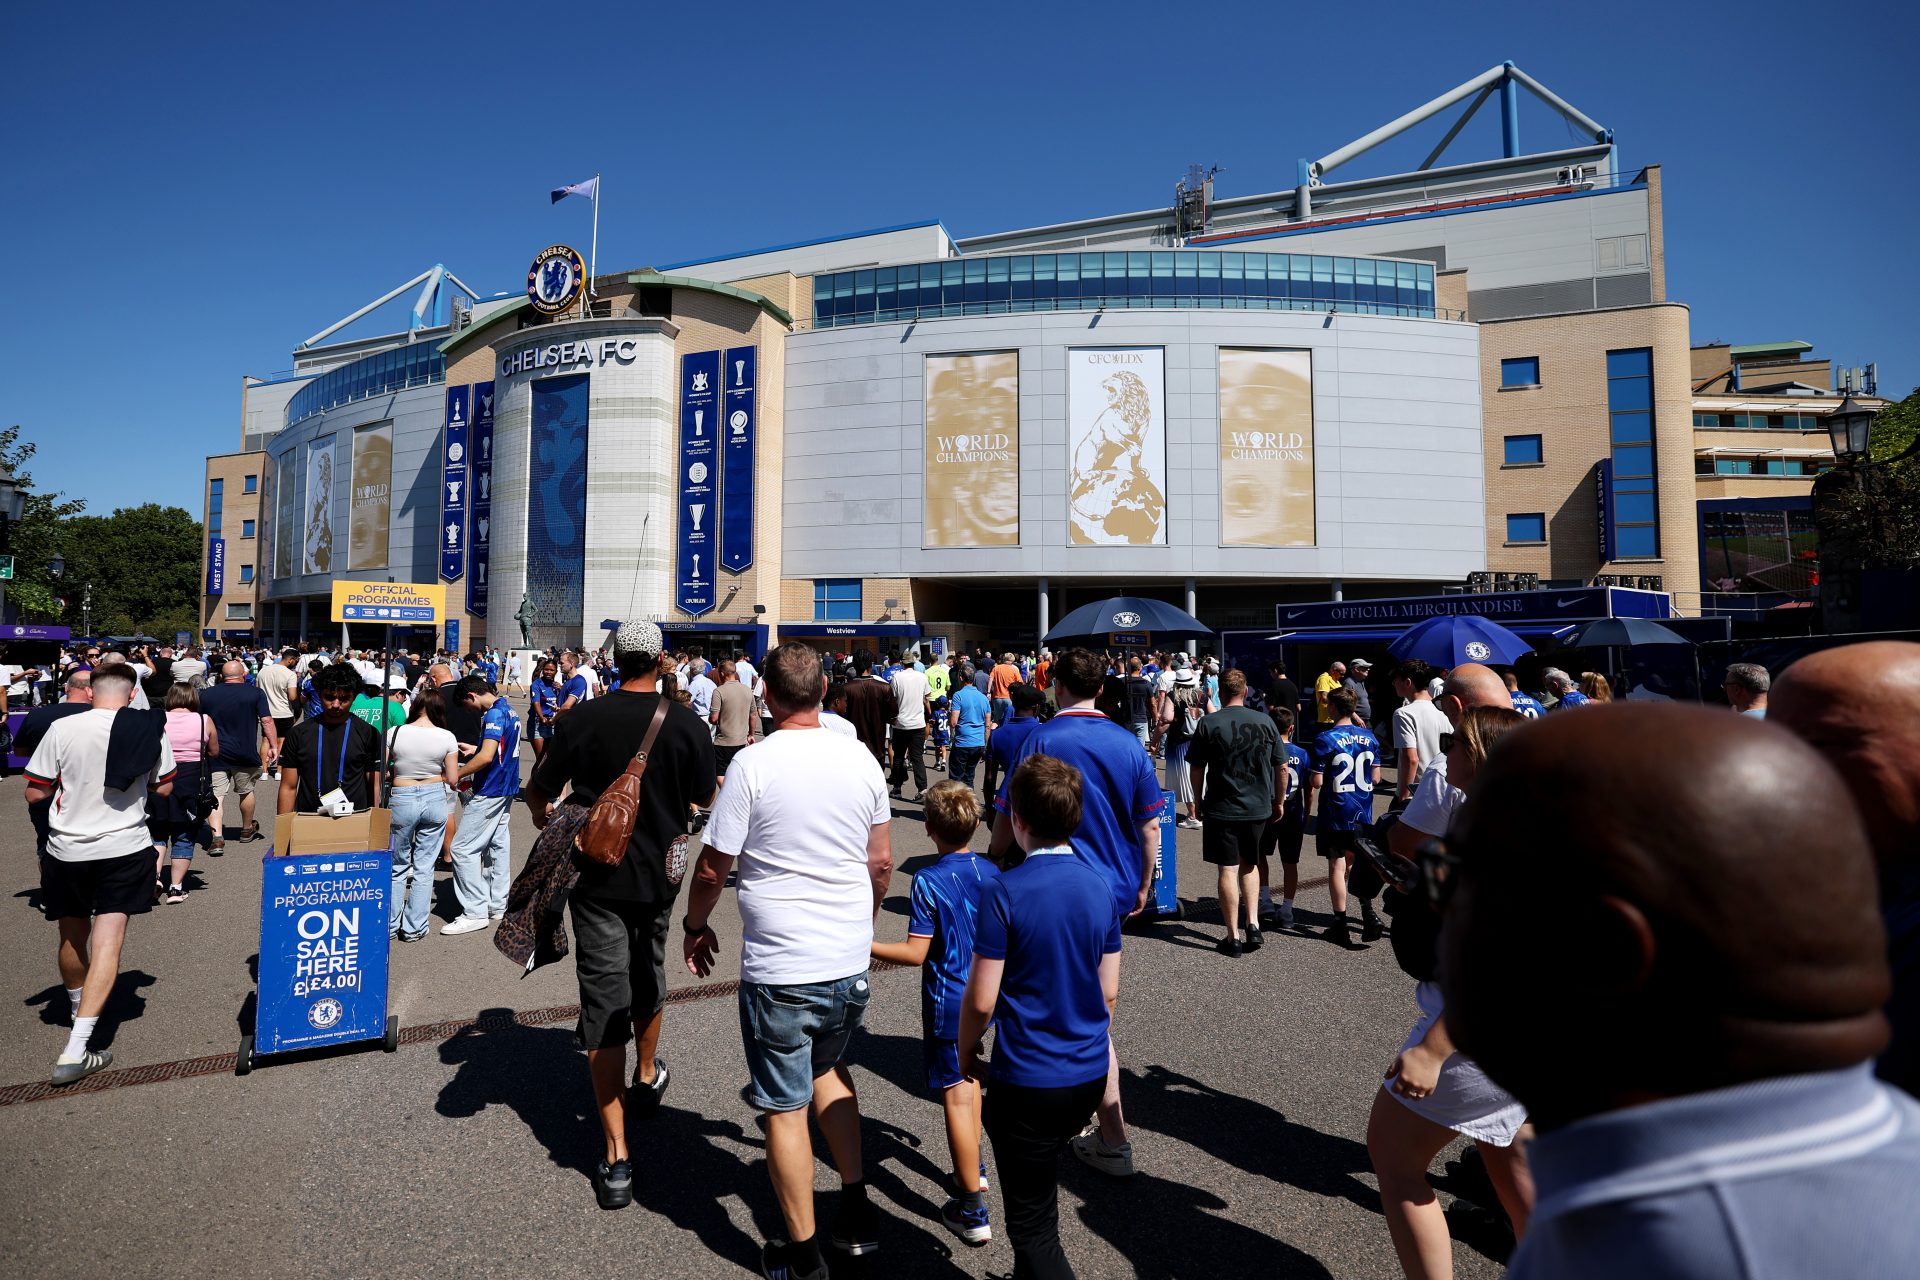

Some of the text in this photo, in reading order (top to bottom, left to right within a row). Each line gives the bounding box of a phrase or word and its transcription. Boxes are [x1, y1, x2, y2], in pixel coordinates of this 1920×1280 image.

[536, 246, 573, 264] CHELSEA
[501, 338, 637, 377] CHELSEA FC
[936, 433, 1009, 452] WORLD
[1231, 431, 1303, 449] WORLD
[936, 450, 1009, 463] CHAMPIONS
[1231, 448, 1303, 460] CHAMPIONS
[356, 483, 388, 499] WORLD
[355, 497, 388, 508] CHAMPIONS
[363, 584, 417, 595] OFFICIAL
[348, 594, 431, 606] PROGRAMMES
[1331, 599, 1523, 619] OFFICIAL MERCHANDISE
[935, 677, 942, 689] 8
[1337, 735, 1370, 748] PALMER
[1288, 756, 1300, 765] RD
[1332, 751, 1374, 793] 20
[290, 877, 371, 895] MATCHDAY
[274, 888, 384, 908] PROGRAMMES
[297, 907, 360, 940] ON
[296, 936, 359, 959] SALE
[296, 954, 358, 977] HERE
[282, 1036, 308, 1044] PROGRAMME
